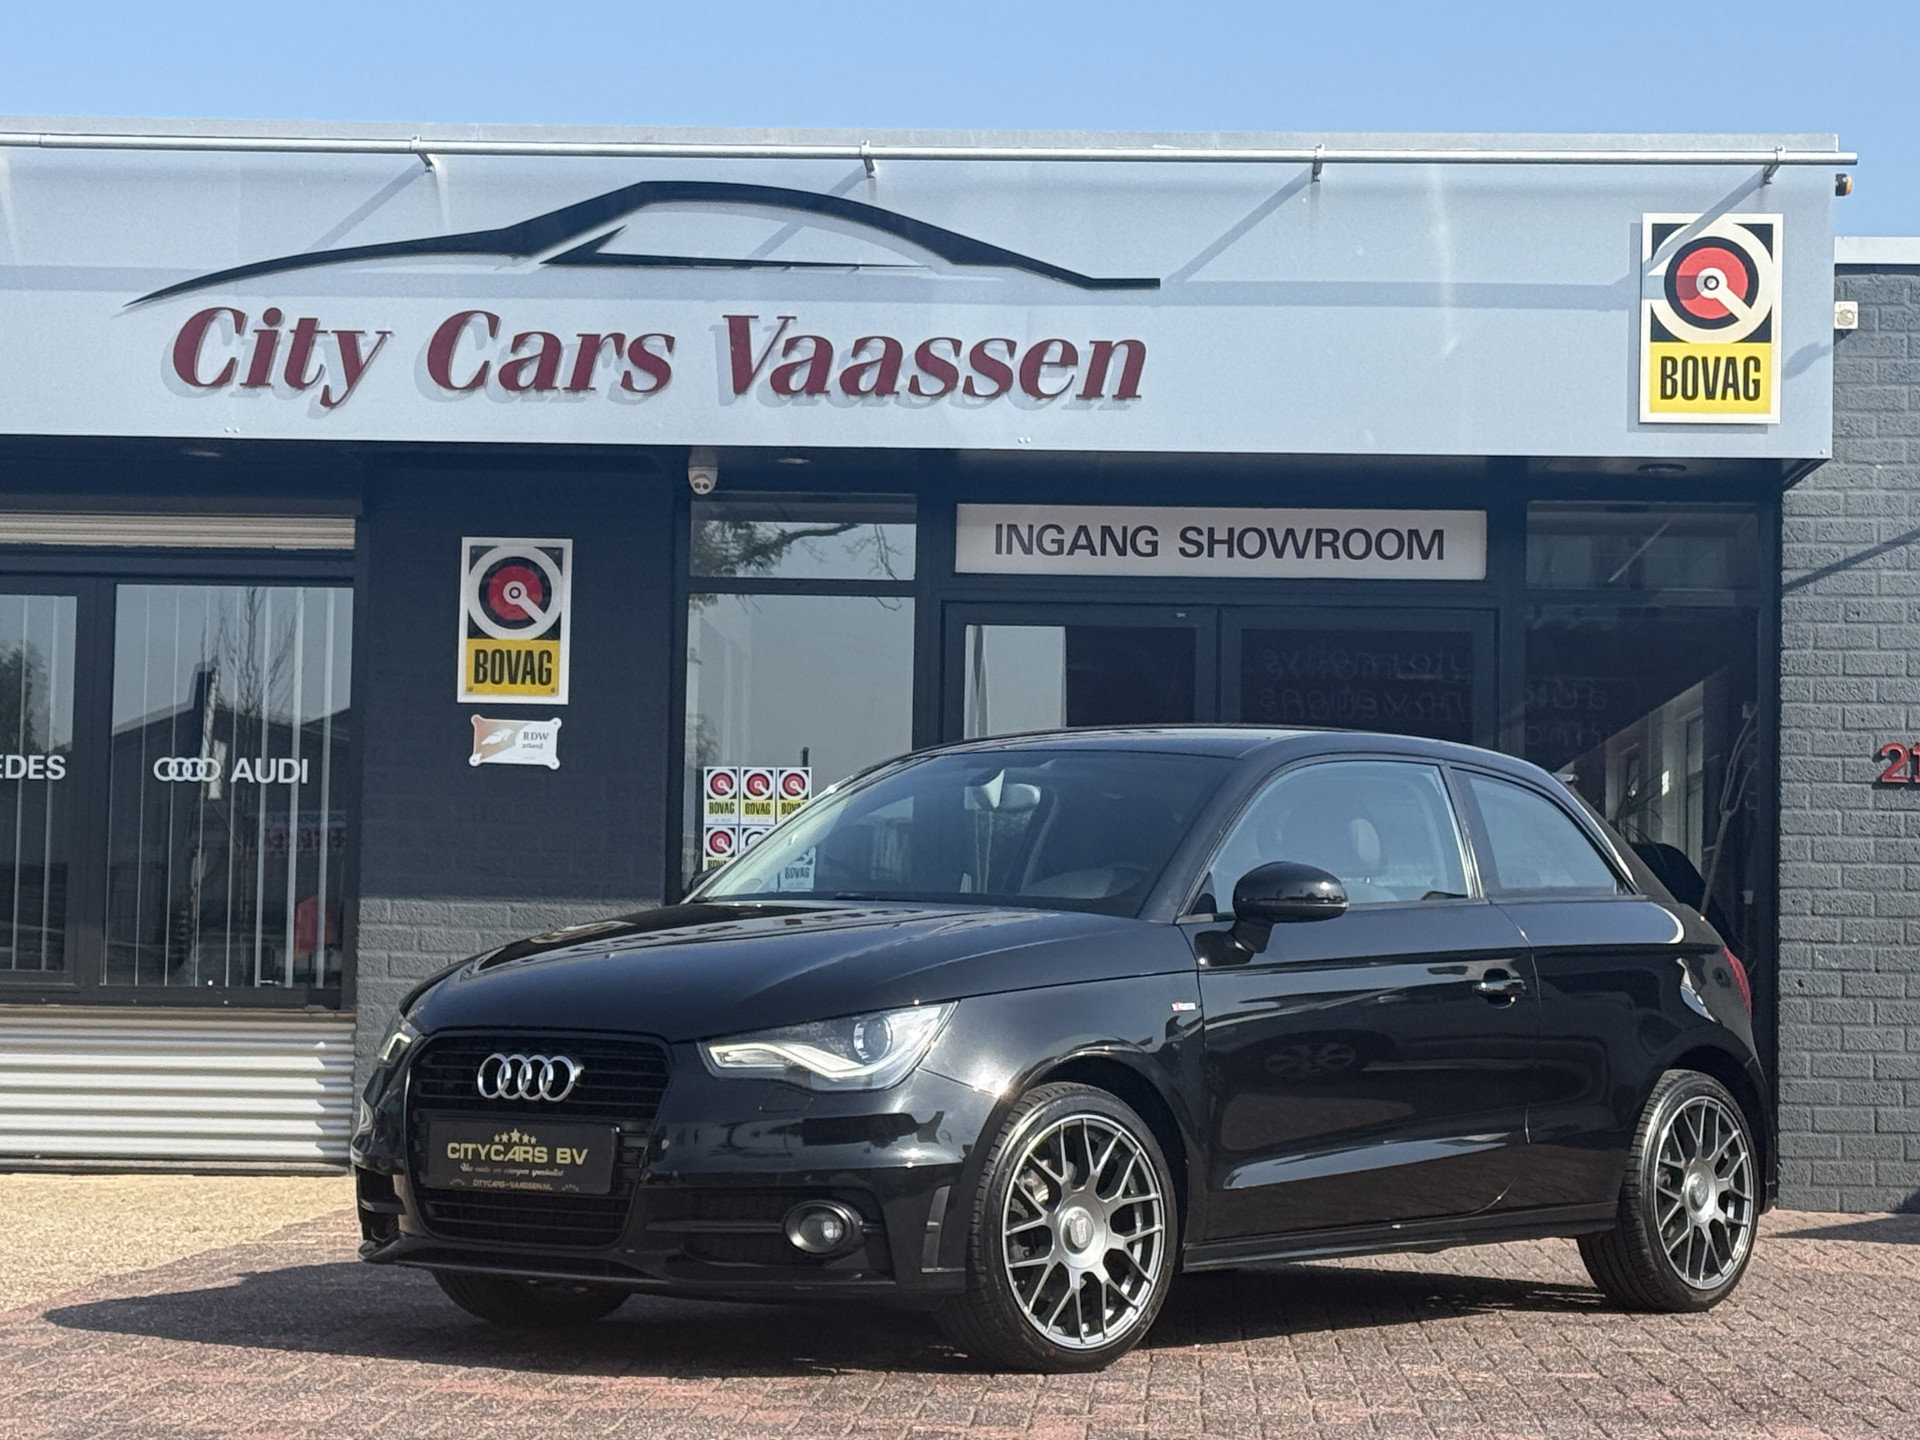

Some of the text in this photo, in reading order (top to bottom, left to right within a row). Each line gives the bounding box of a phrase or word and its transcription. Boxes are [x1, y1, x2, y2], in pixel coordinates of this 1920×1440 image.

[172, 307, 1147, 410] City Cars Vaassen
[1660, 355, 1762, 401] BOVAG
[994, 523, 1445, 561] INGANG SHOWROOM
[473, 648, 553, 686] BOVAG
[523, 731, 550, 741] RDW
[0, 754, 66, 780] DES
[230, 757, 309, 784] AUDI
[709, 801, 735, 815] BOVAG
[745, 802, 771, 815] BOVAG
[781, 802, 806, 815] BOV
[785, 866, 810, 880] BOVAG
[446, 1142, 589, 1166] CITYCARS BV
